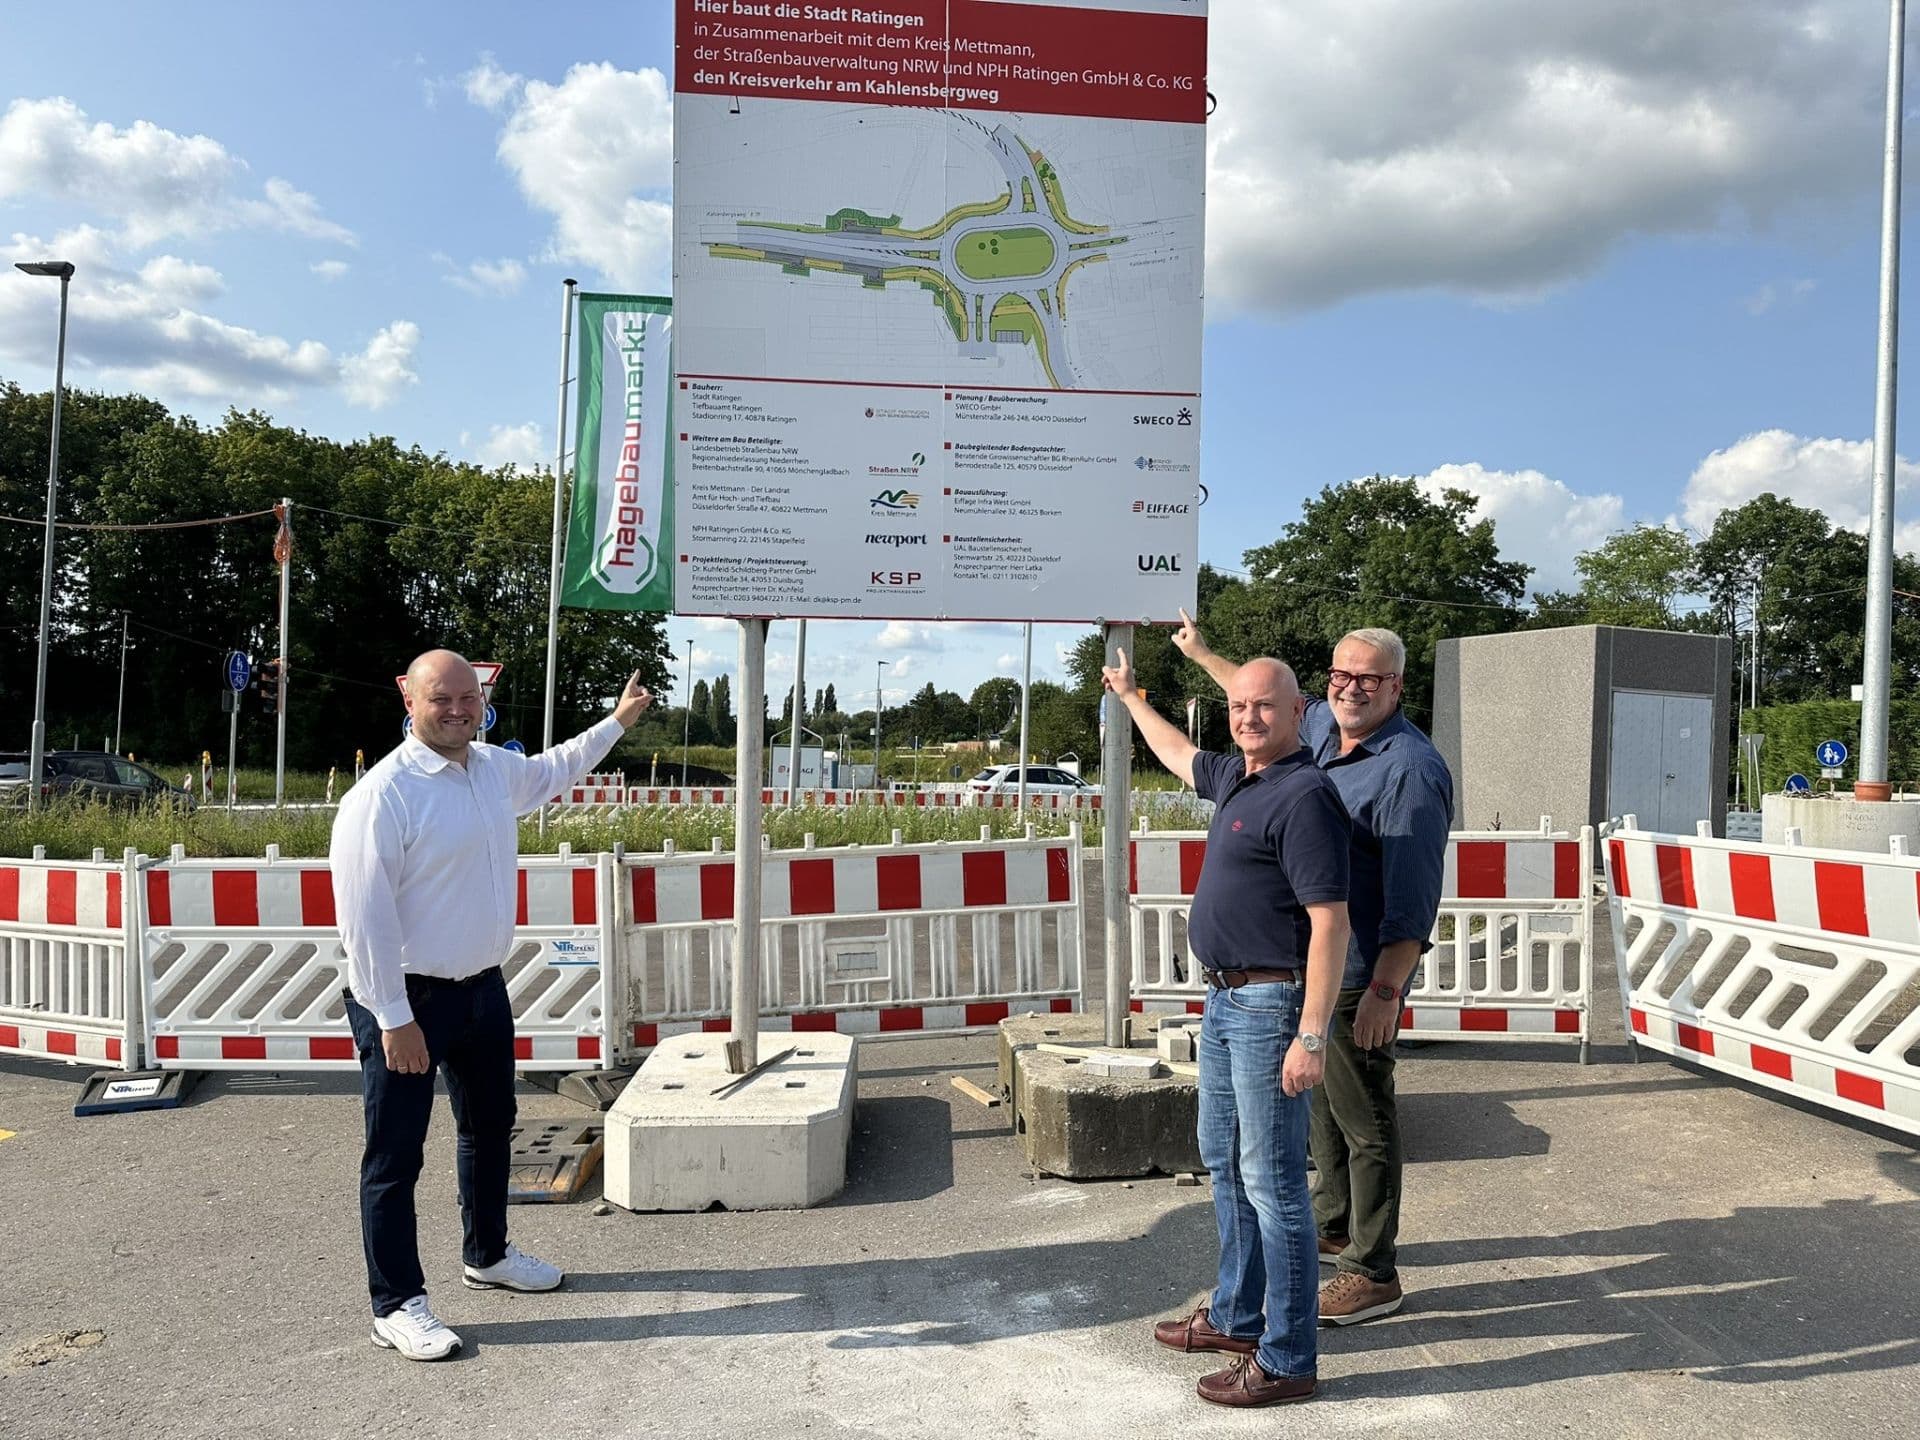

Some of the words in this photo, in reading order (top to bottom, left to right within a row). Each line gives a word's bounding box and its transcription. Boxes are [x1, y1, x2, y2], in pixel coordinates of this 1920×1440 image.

[694, 0, 728, 14] Hier
[732, 0, 771, 16] baut
[774, 3, 800, 18] die
[804, 5, 848, 22] Stadt
[851, 9, 924, 28] Ratingen
[694, 22, 708, 36] in
[712, 23, 844, 45] Zusammenarbeit
[848, 32, 872, 46] mit
[877, 33, 910, 48] dem
[915, 36, 950, 51] Kreis
[954, 38, 1036, 58] Mettmann,
[694, 45, 719, 60] der
[723, 48, 898, 75] Straßenbauverwaltung
[902, 59, 939, 74] NRW
[943, 61, 972, 76] und
[977, 62, 1008, 77] NPH
[1013, 65, 1078, 85] Ratingen
[1082, 69, 1129, 86] GmbH
[1132, 73, 1143, 87] &
[1147, 74, 1169, 88] Co.
[1173, 75, 1192, 90] KG
[693, 69, 724, 84] den
[729, 71, 832, 91] Kreisverkehr
[836, 78, 861, 93] am
[865, 80, 999, 104] Kahlensbergweg
[692, 383, 723, 391] Bauherr:
[712, 394, 742, 403] Ratingen
[955, 394, 984, 402] Planung
[692, 402, 731, 410] Tiefbauamt
[732, 404, 762, 413] Ratingen
[692, 412, 732, 422] Stadionring
[767, 415, 798, 424] Ratingen
[1133, 415, 1174, 426] SWECO
[609, 318, 647, 567] hagebaumarkt
[692, 444, 740, 452] Landesbetrieb
[710, 484, 746, 492] Mettmann
[751, 485, 763, 493] Der
[755, 495, 780, 503] Tiefbau
[792, 506, 828, 514] Mettmann
[1146, 503, 1190, 514] EIFFAGE
[708, 525, 740, 534] Ratingen
[865, 534, 928, 548] newport
[1138, 554, 1181, 572] UAL
[871, 571, 922, 585] KSP
